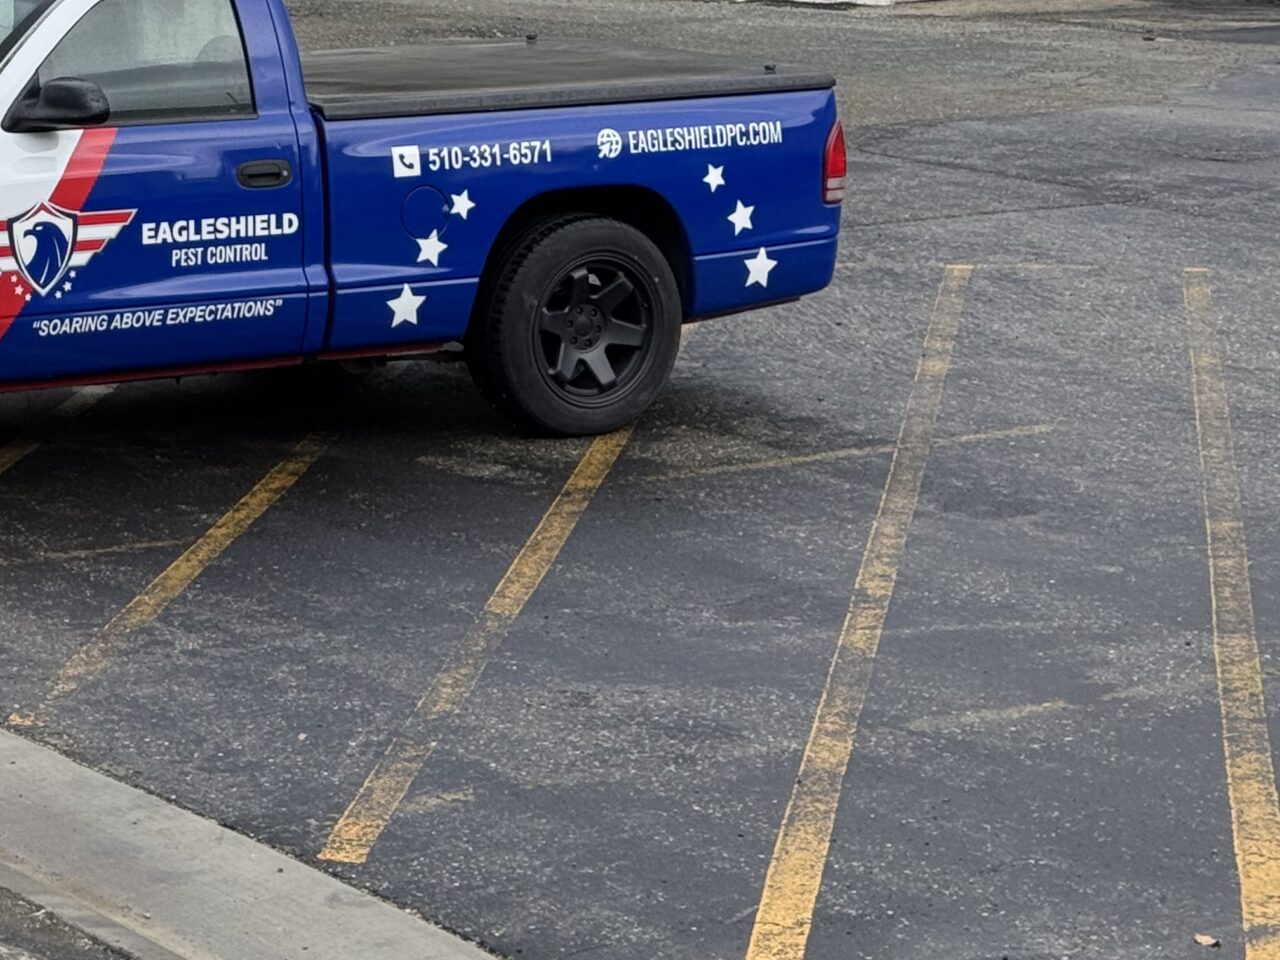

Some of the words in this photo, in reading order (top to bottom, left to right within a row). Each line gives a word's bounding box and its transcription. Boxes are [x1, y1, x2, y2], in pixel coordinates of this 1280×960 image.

[629, 121, 782, 153] EAGLESHIELDPC.COM
[428, 140, 552, 171] 510-331-6571
[141, 212, 299, 245] EAGLESHIELD
[171, 248, 204, 267] PEST
[207, 243, 268, 264] CONTROL
[110, 311, 163, 330] ABOVE
